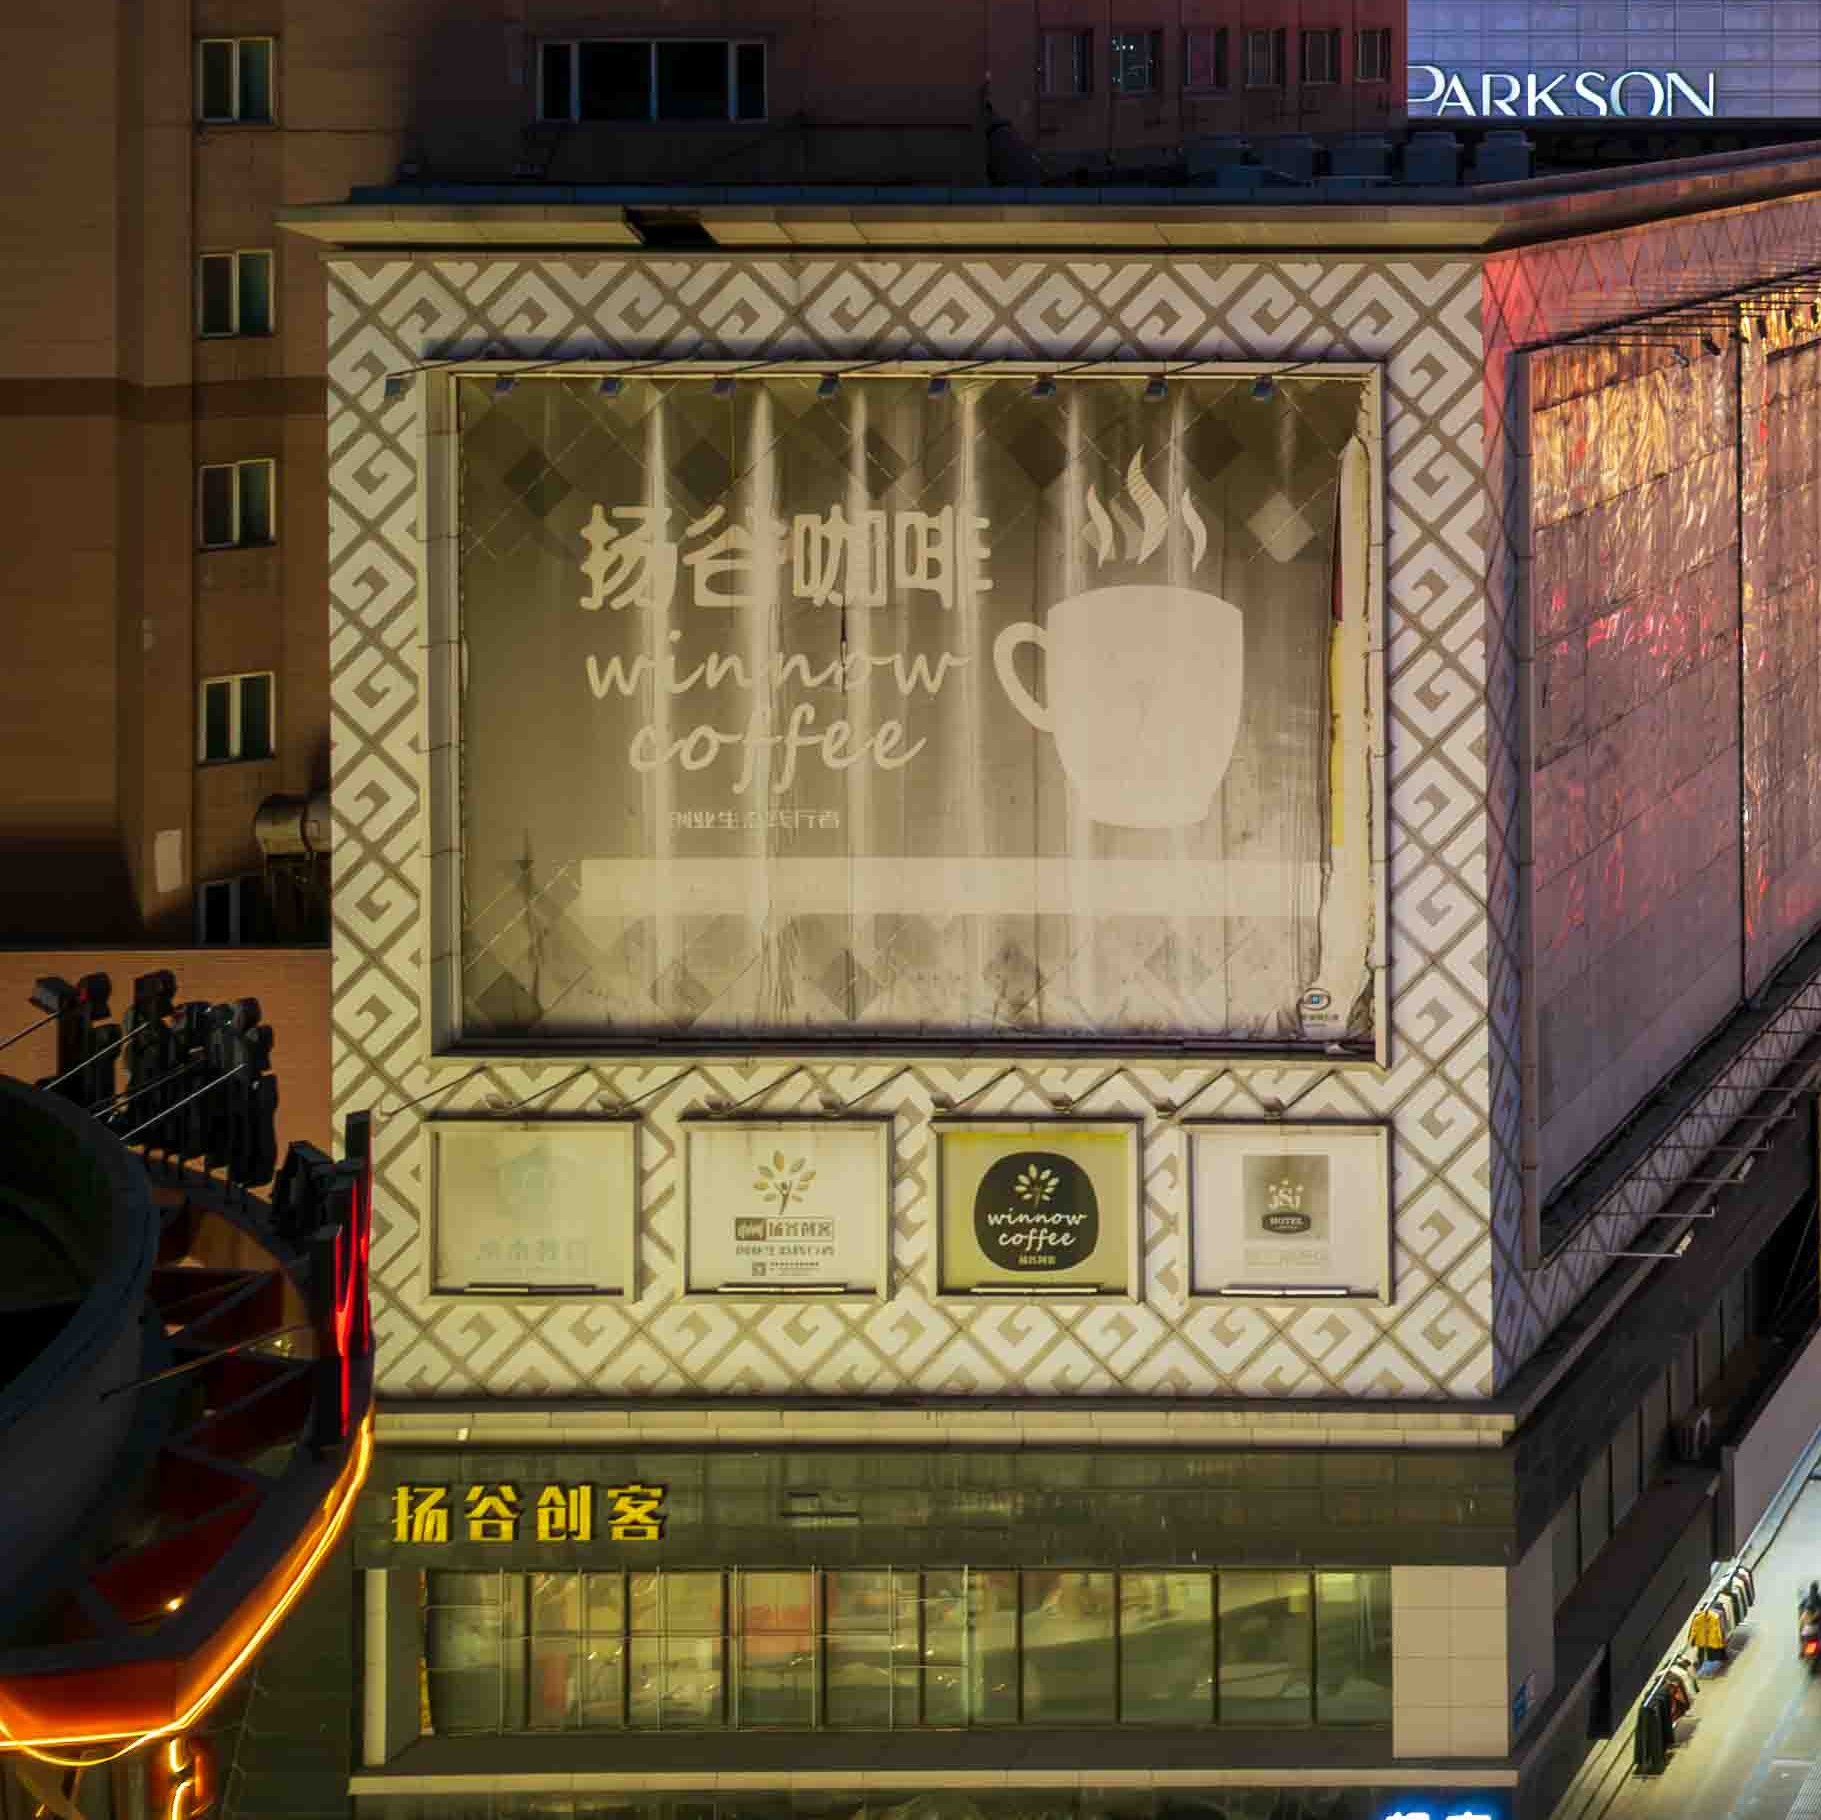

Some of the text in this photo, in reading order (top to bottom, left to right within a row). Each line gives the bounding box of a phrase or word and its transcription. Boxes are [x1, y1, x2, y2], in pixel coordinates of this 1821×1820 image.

[1408, 65, 1715, 117] PARKSON
[581, 503, 993, 612] 扬谷咖啡
[585, 629, 972, 699] winnow
[629, 702, 926, 795] coffee
[987, 1207, 1089, 1228] winnow
[998, 1227, 1076, 1251] coffee
[390, 1483, 667, 1544] 扬谷创客
